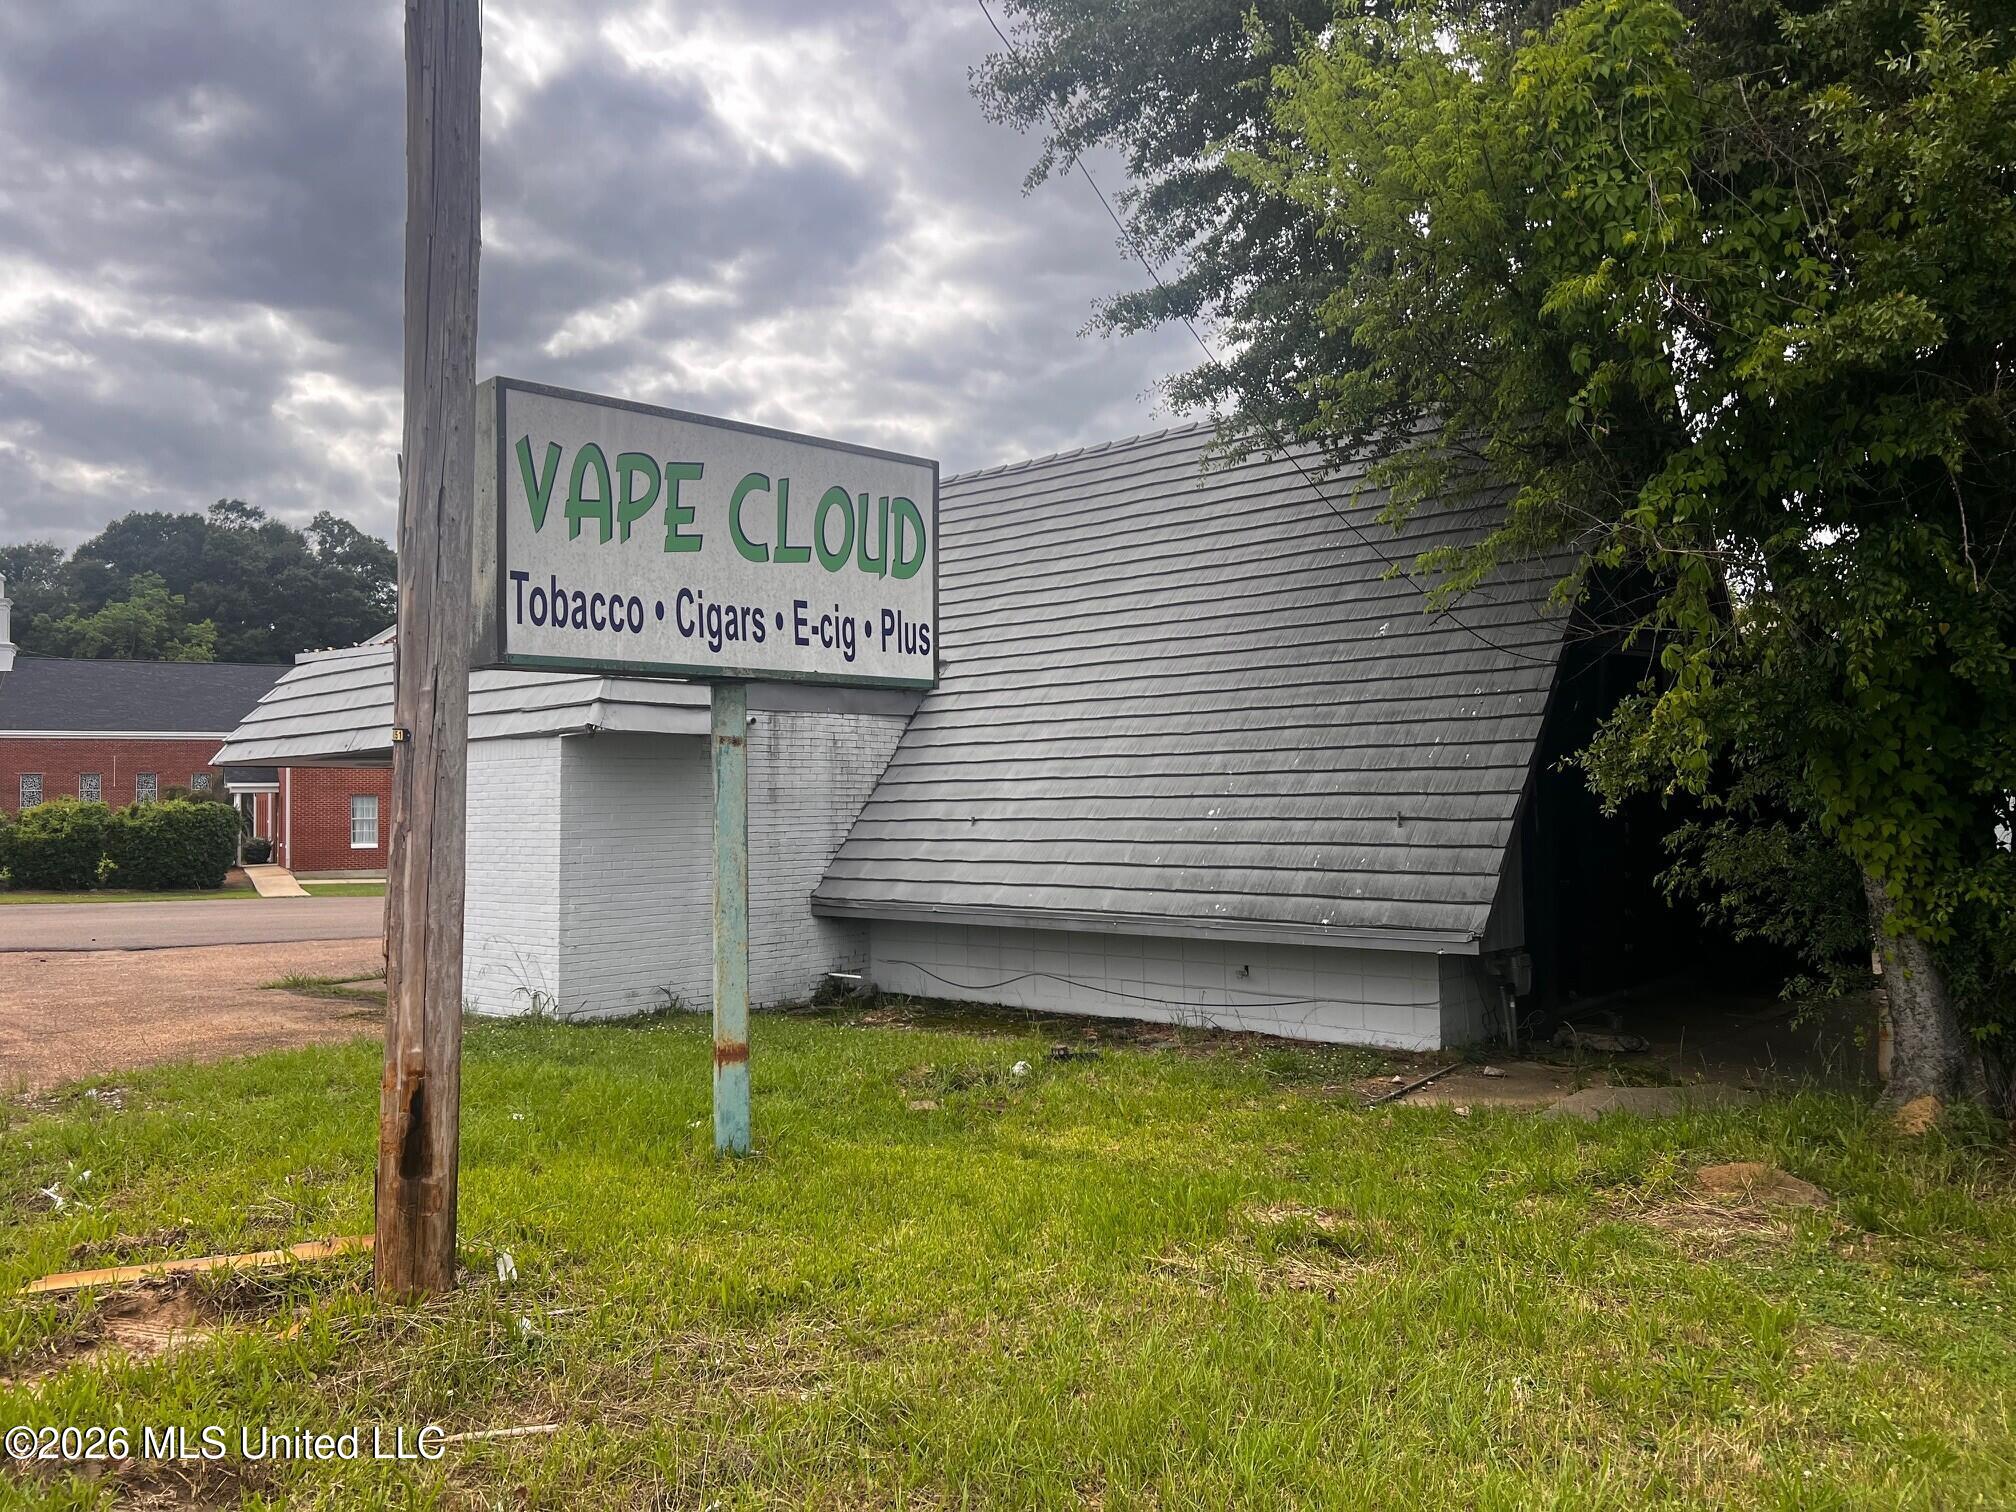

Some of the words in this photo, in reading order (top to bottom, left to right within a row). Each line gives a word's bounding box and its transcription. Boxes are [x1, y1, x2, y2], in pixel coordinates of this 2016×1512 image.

[515, 434, 705, 553] VAPE
[729, 472, 927, 581] CLOUD
[510, 570, 645, 634] Tobacco
[676, 587, 766, 653] Cigars
[793, 600, 856, 662] E-cig
[881, 608, 931, 656] Plus
